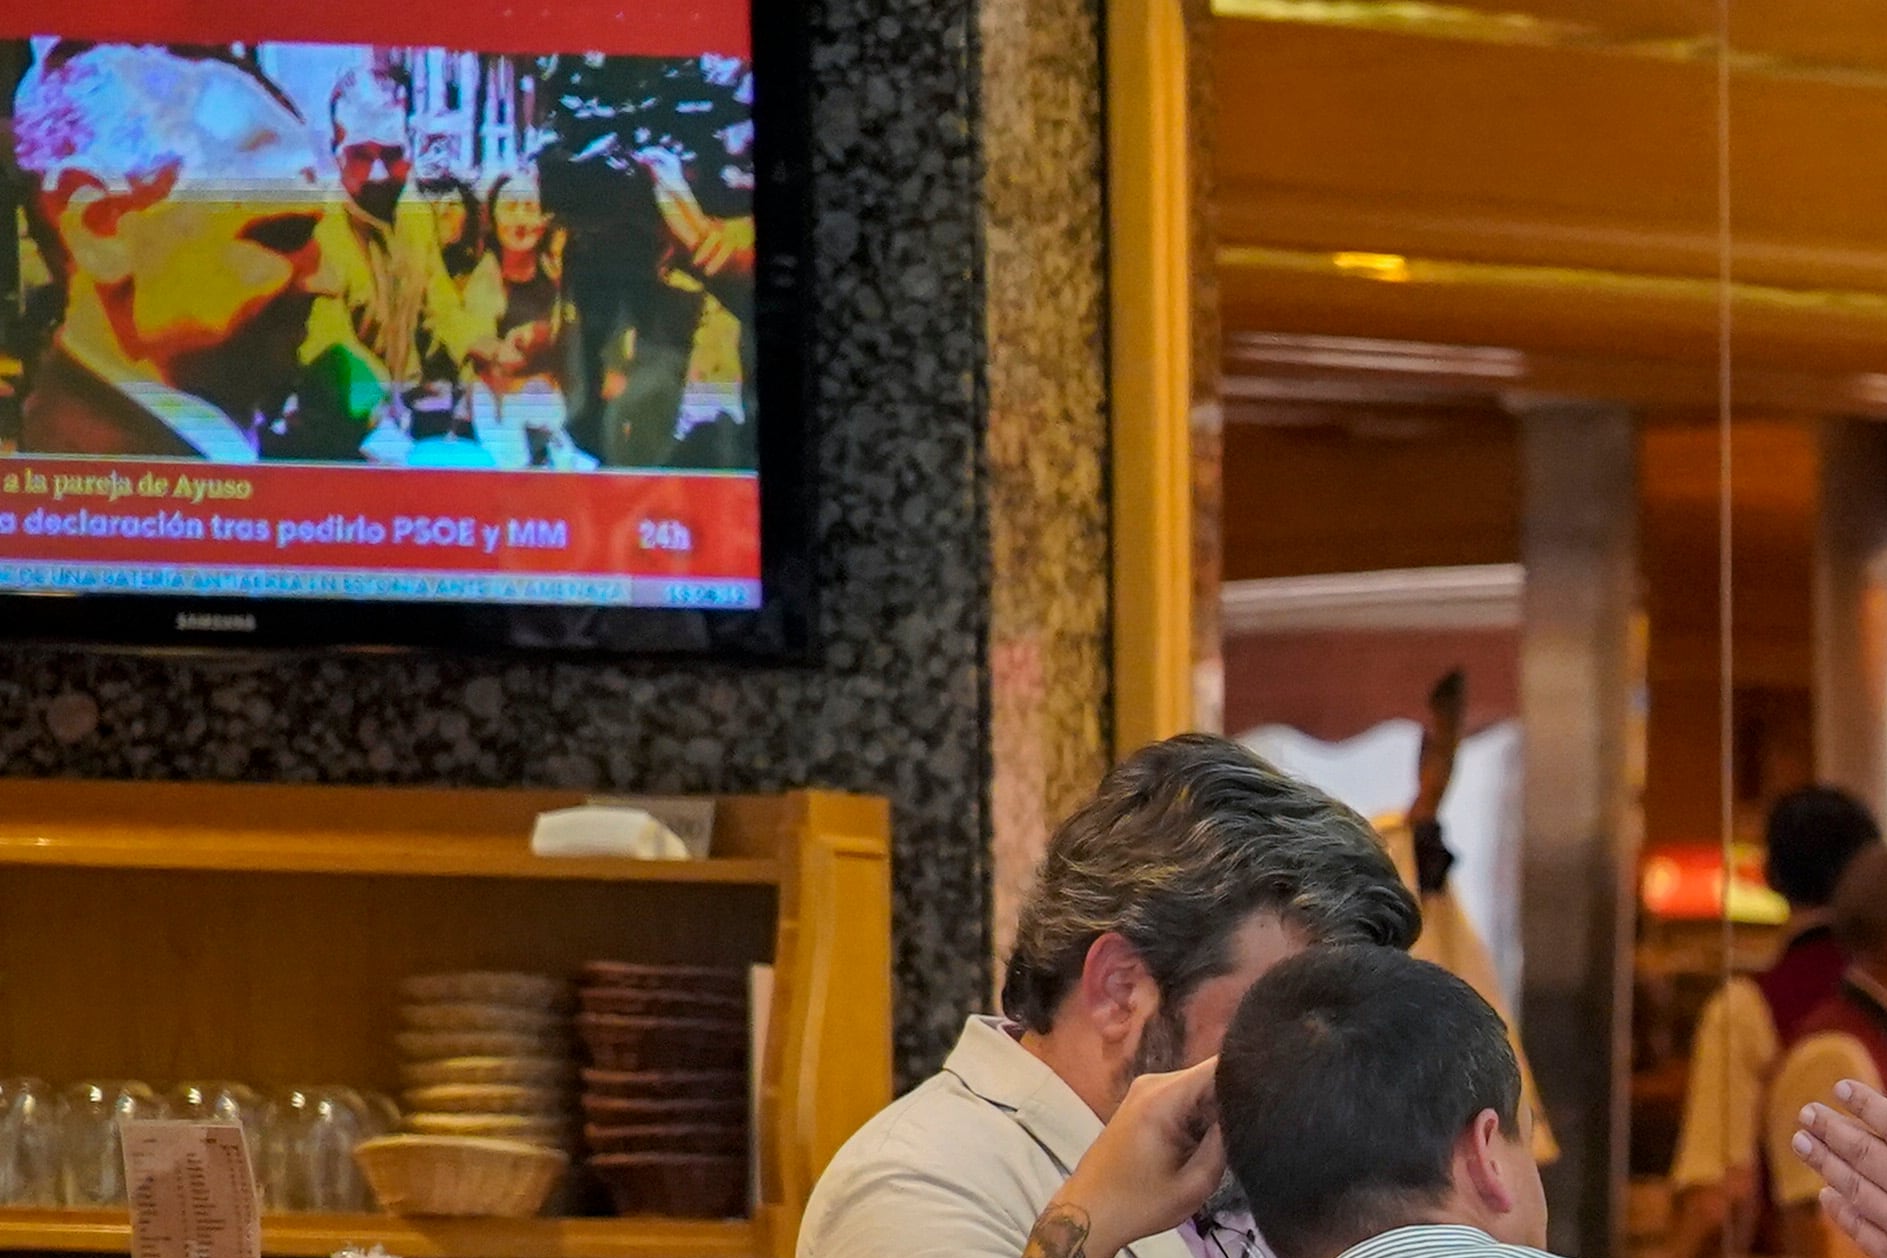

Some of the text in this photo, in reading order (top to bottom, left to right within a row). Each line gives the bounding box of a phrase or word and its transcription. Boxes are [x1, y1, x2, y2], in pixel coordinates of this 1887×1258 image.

[3, 467, 253, 504] a la pareja de Ayuso
[23, 507, 204, 539] declaración
[210, 514, 271, 541] tras
[276, 514, 386, 548] pedirlo
[393, 516, 476, 546] PSOE
[482, 523, 500, 554] y
[506, 518, 568, 548] MM
[639, 518, 692, 550] 24h
